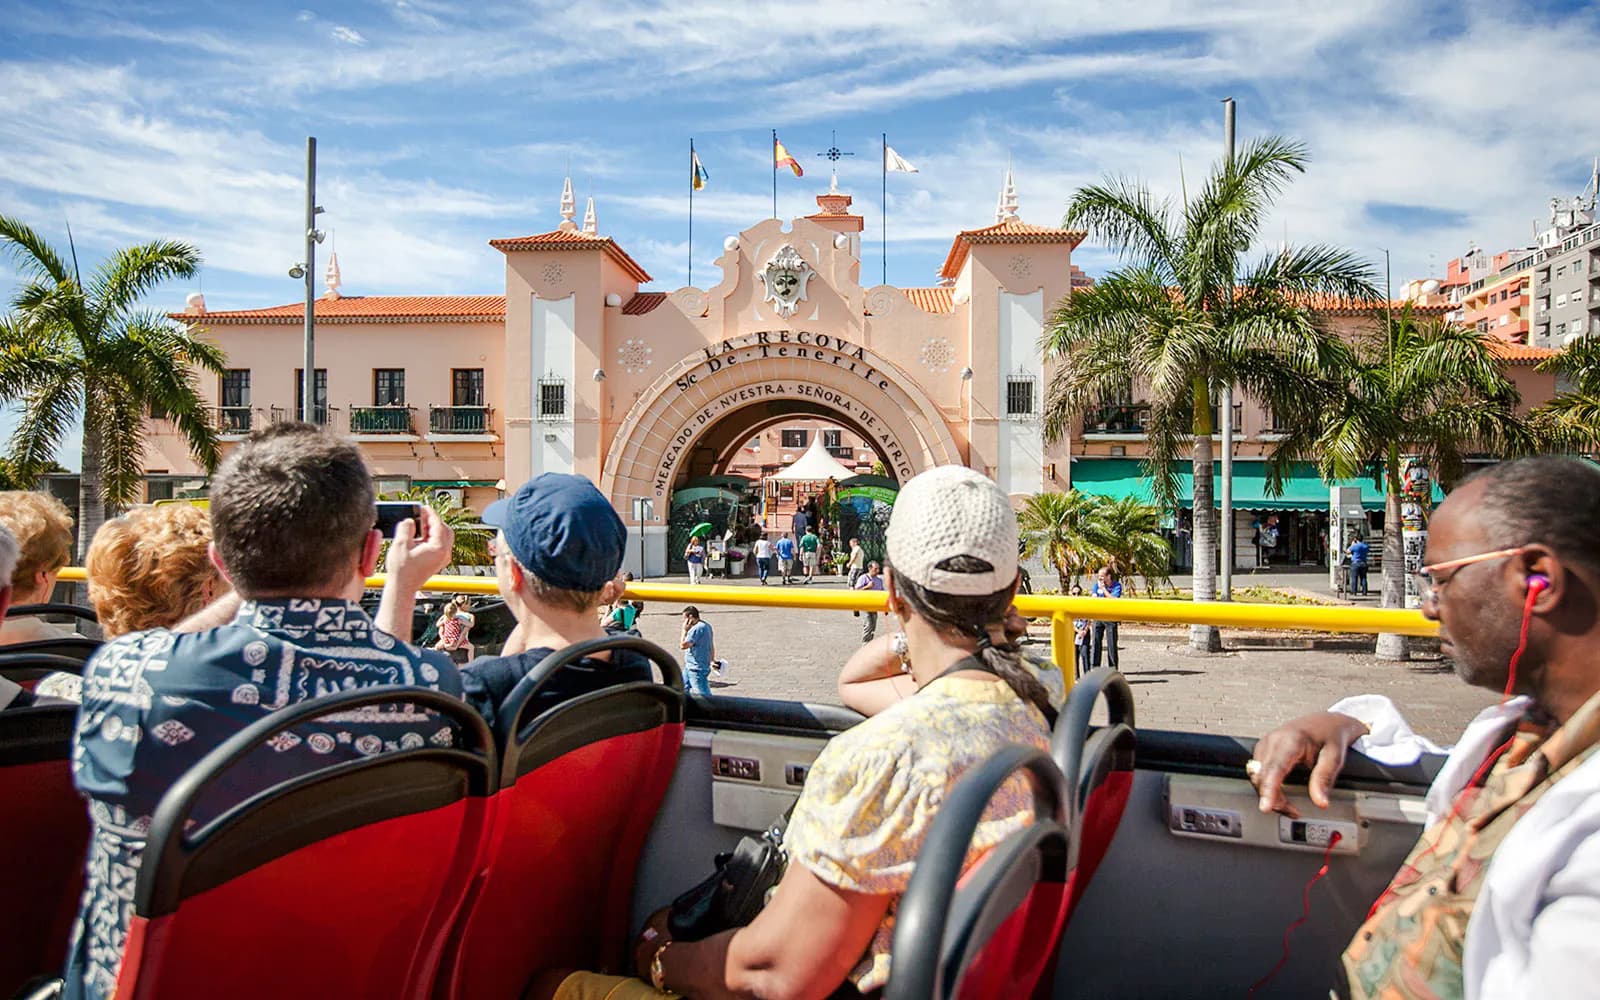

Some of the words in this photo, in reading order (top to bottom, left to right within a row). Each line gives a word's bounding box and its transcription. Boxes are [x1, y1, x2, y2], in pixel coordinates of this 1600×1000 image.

[703, 339, 736, 360] LA
[756, 330, 865, 361] RECOVA
[707, 355, 737, 373] De
[759, 345, 889, 391] Tenerife
[655, 428, 693, 490] MERCADO
[696, 408, 714, 425] DE
[719, 384, 786, 409] NVESTRA
[796, 384, 851, 411] SEÑORA
[859, 410, 877, 428] DE
[879, 433, 911, 484] AFRIC
